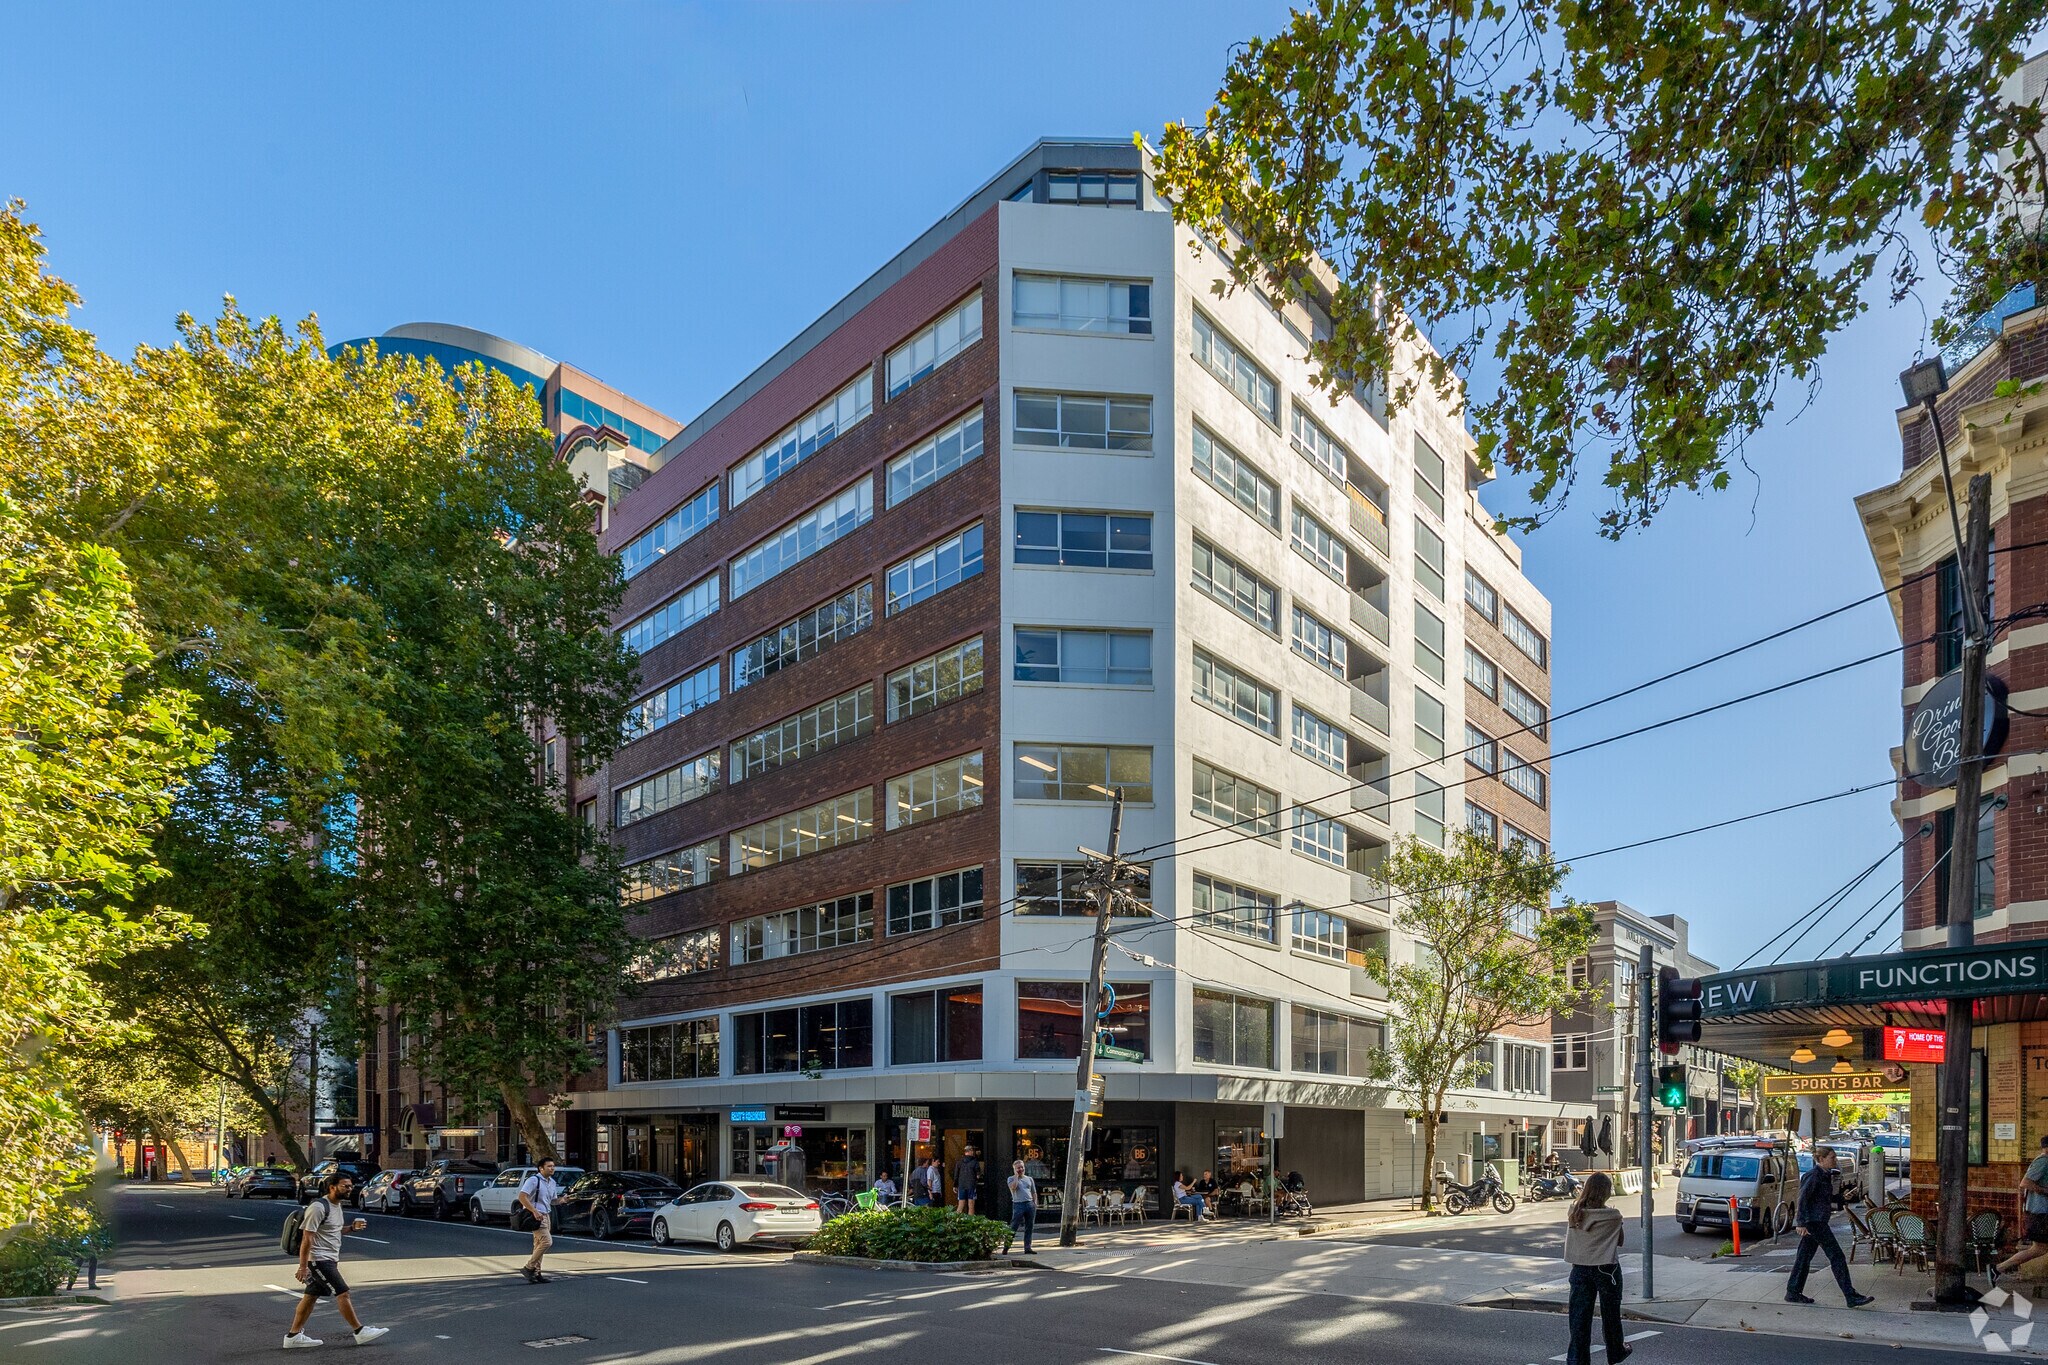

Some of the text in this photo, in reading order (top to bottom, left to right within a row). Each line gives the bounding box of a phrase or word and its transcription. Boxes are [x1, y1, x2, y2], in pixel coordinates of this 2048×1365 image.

[1912, 697, 1962, 739] Drin
[1932, 737, 1961, 774] Be
[1859, 956, 2037, 990] FUNCTIONS
[1908, 1033, 1944, 1043] HOME OF THE
[1791, 1076, 1883, 1090] SPORTS BAR
